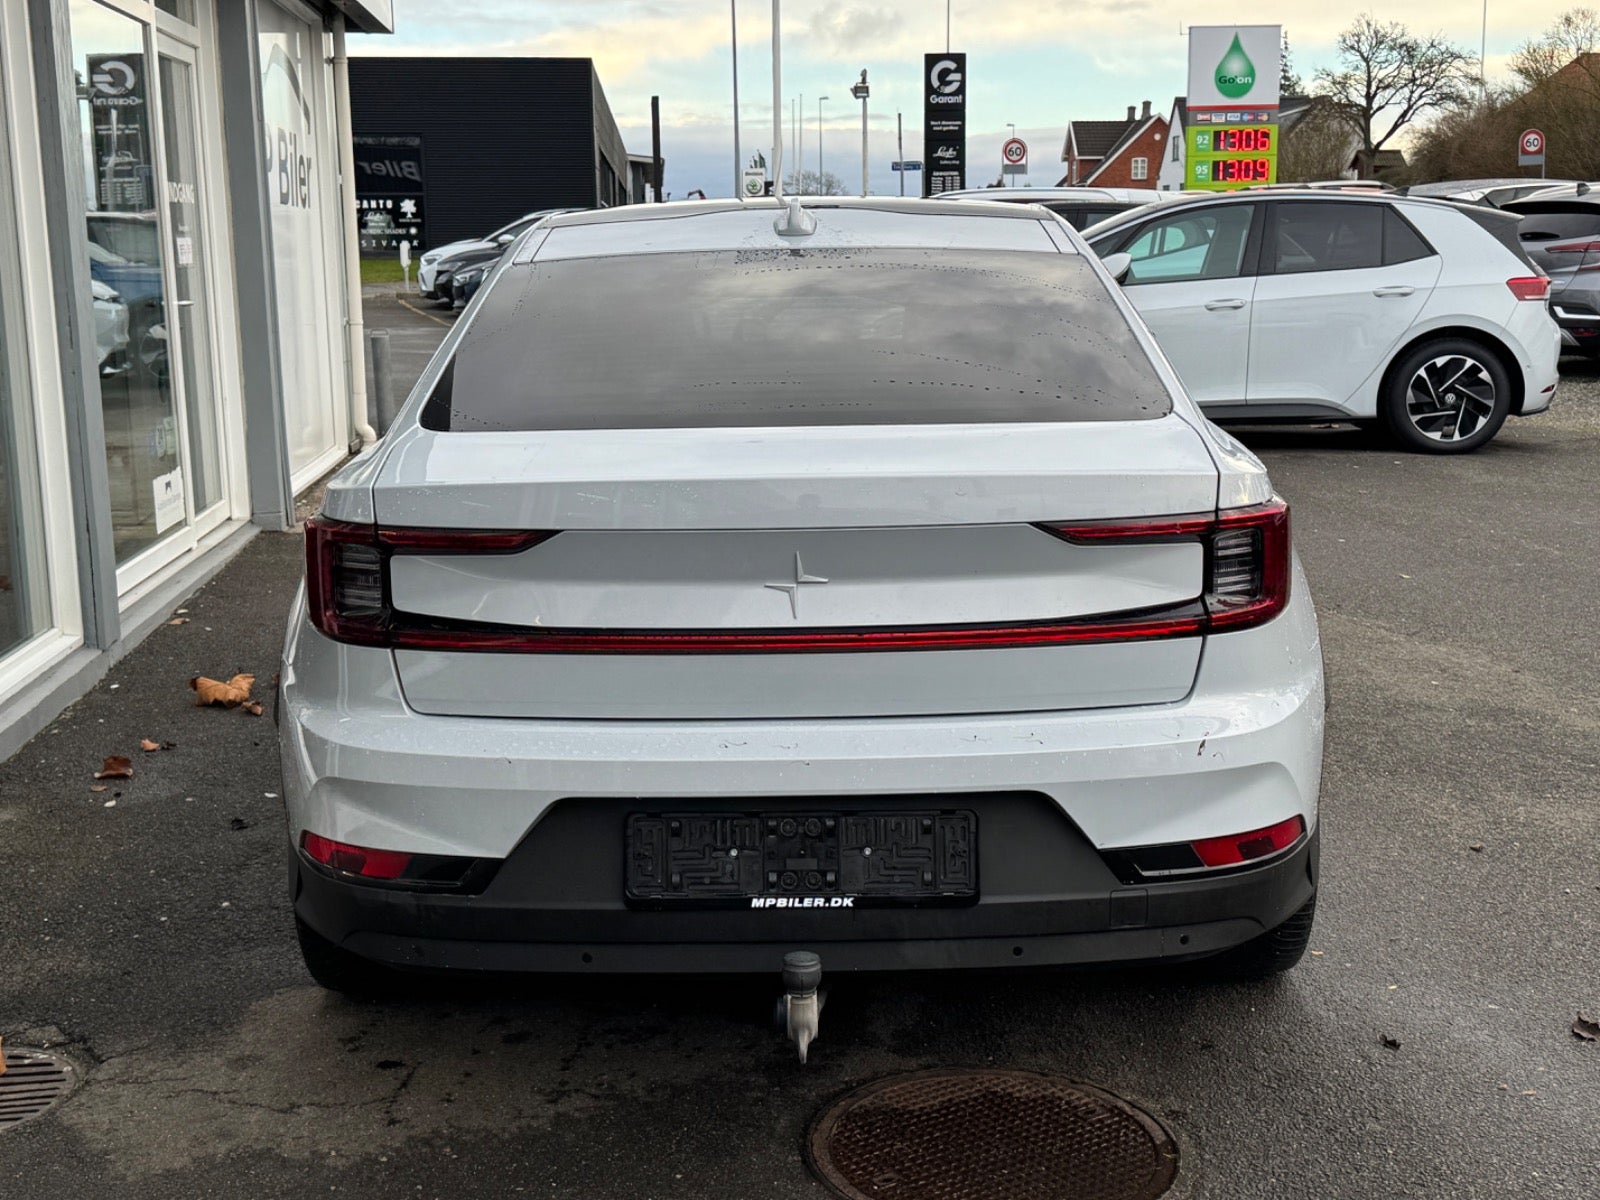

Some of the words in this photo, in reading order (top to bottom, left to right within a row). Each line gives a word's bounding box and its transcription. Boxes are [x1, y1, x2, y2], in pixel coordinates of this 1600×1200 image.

[1218, 75, 1253, 85] Go'on
[930, 94, 962, 104] Garant
[1196, 135, 1210, 145] 92
[1524, 137, 1540, 148] 60
[1008, 146, 1022, 157] 60
[278, 127, 312, 209] Biler
[1195, 165, 1209, 175] 95
[751, 897, 855, 908] MPBILER.DK
